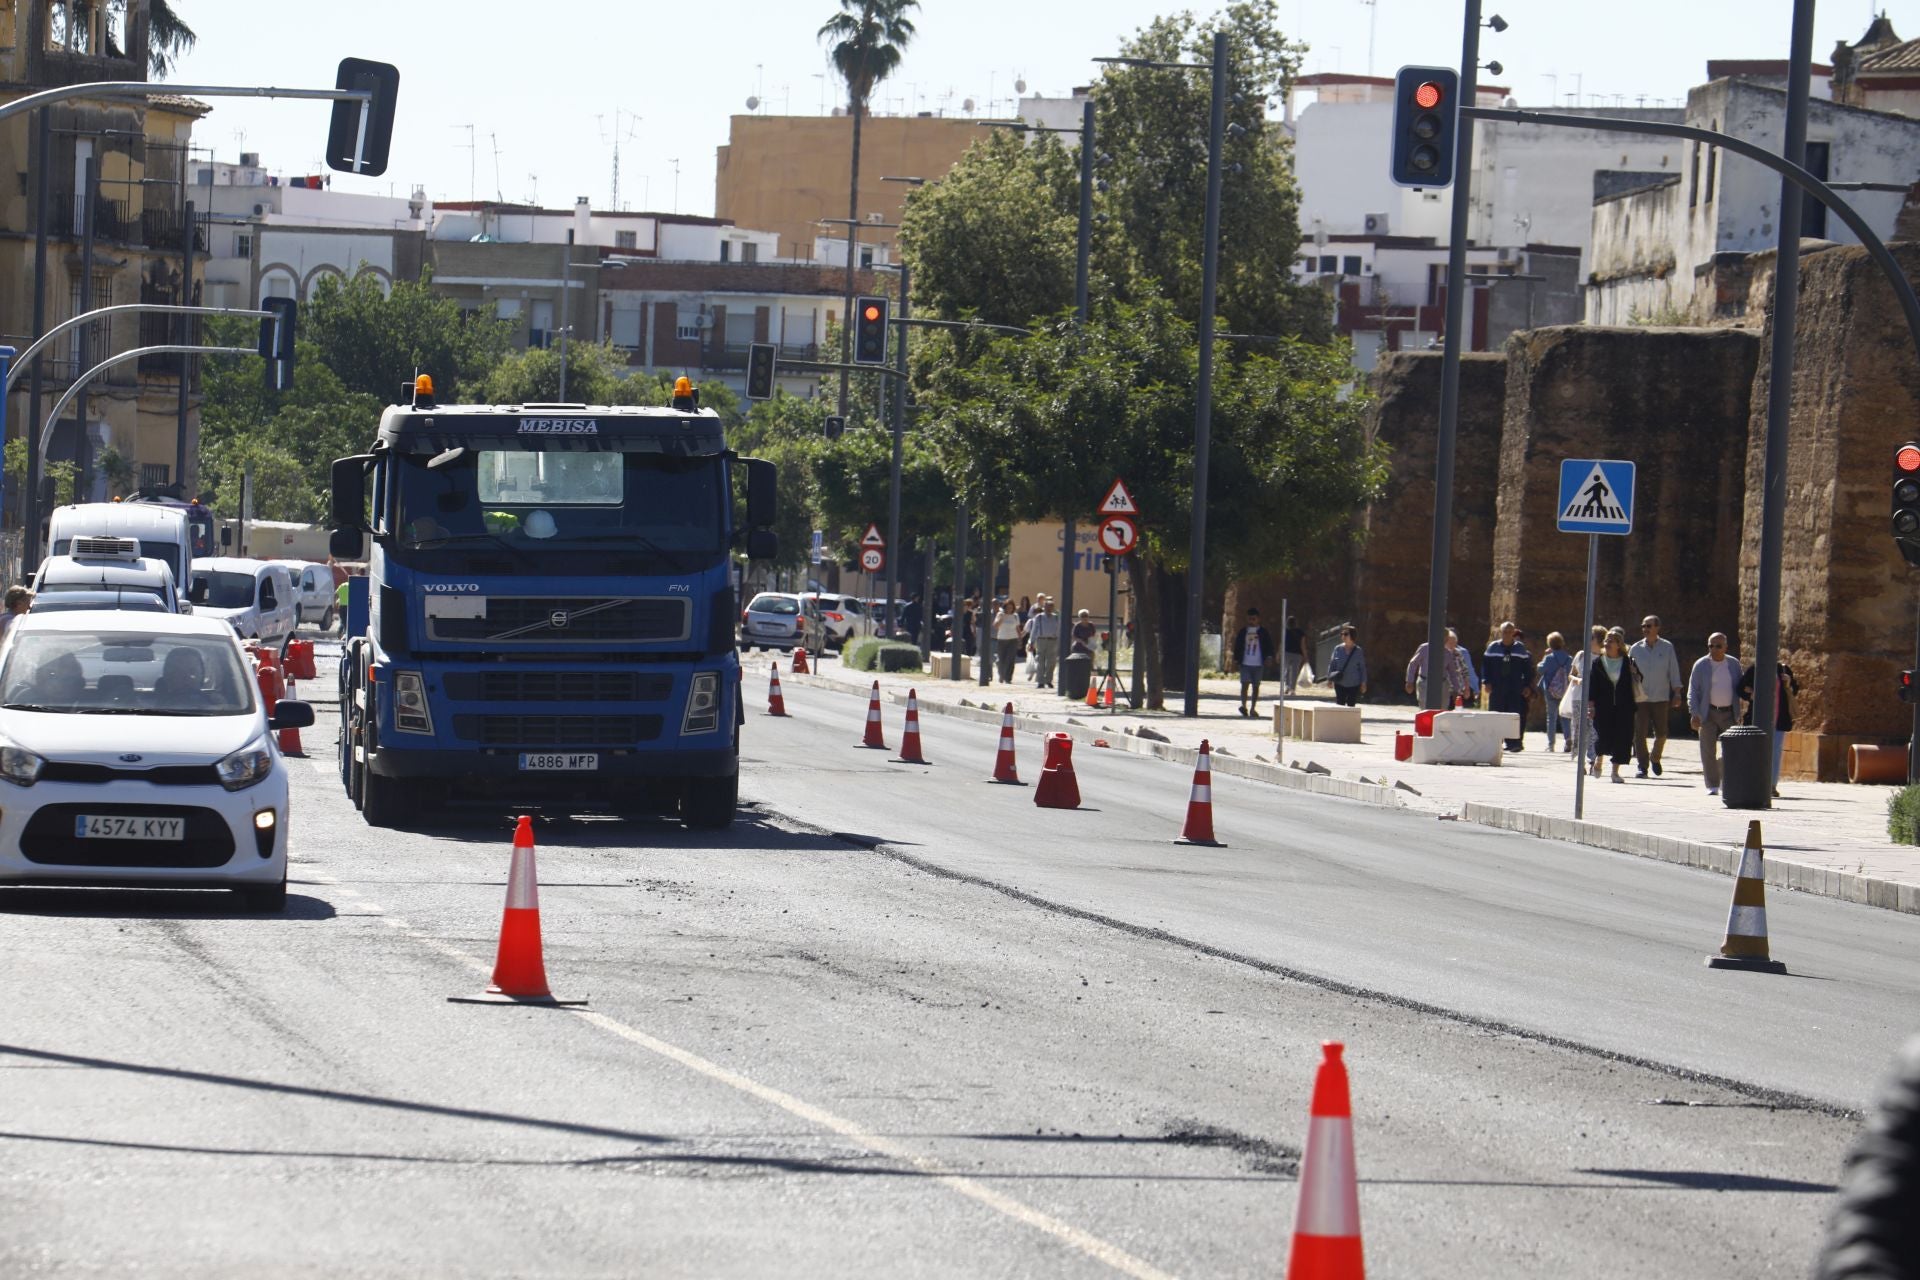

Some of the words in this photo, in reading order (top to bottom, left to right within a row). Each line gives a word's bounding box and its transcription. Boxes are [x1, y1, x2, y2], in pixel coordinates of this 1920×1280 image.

[517, 418, 598, 434] MEBISA
[865, 555, 879, 564] 20
[422, 583, 480, 592] VOLVO
[667, 584, 690, 592] FM
[528, 755, 564, 768] 4886
[90, 818, 137, 836] 4574
[144, 820, 180, 838] KYY
